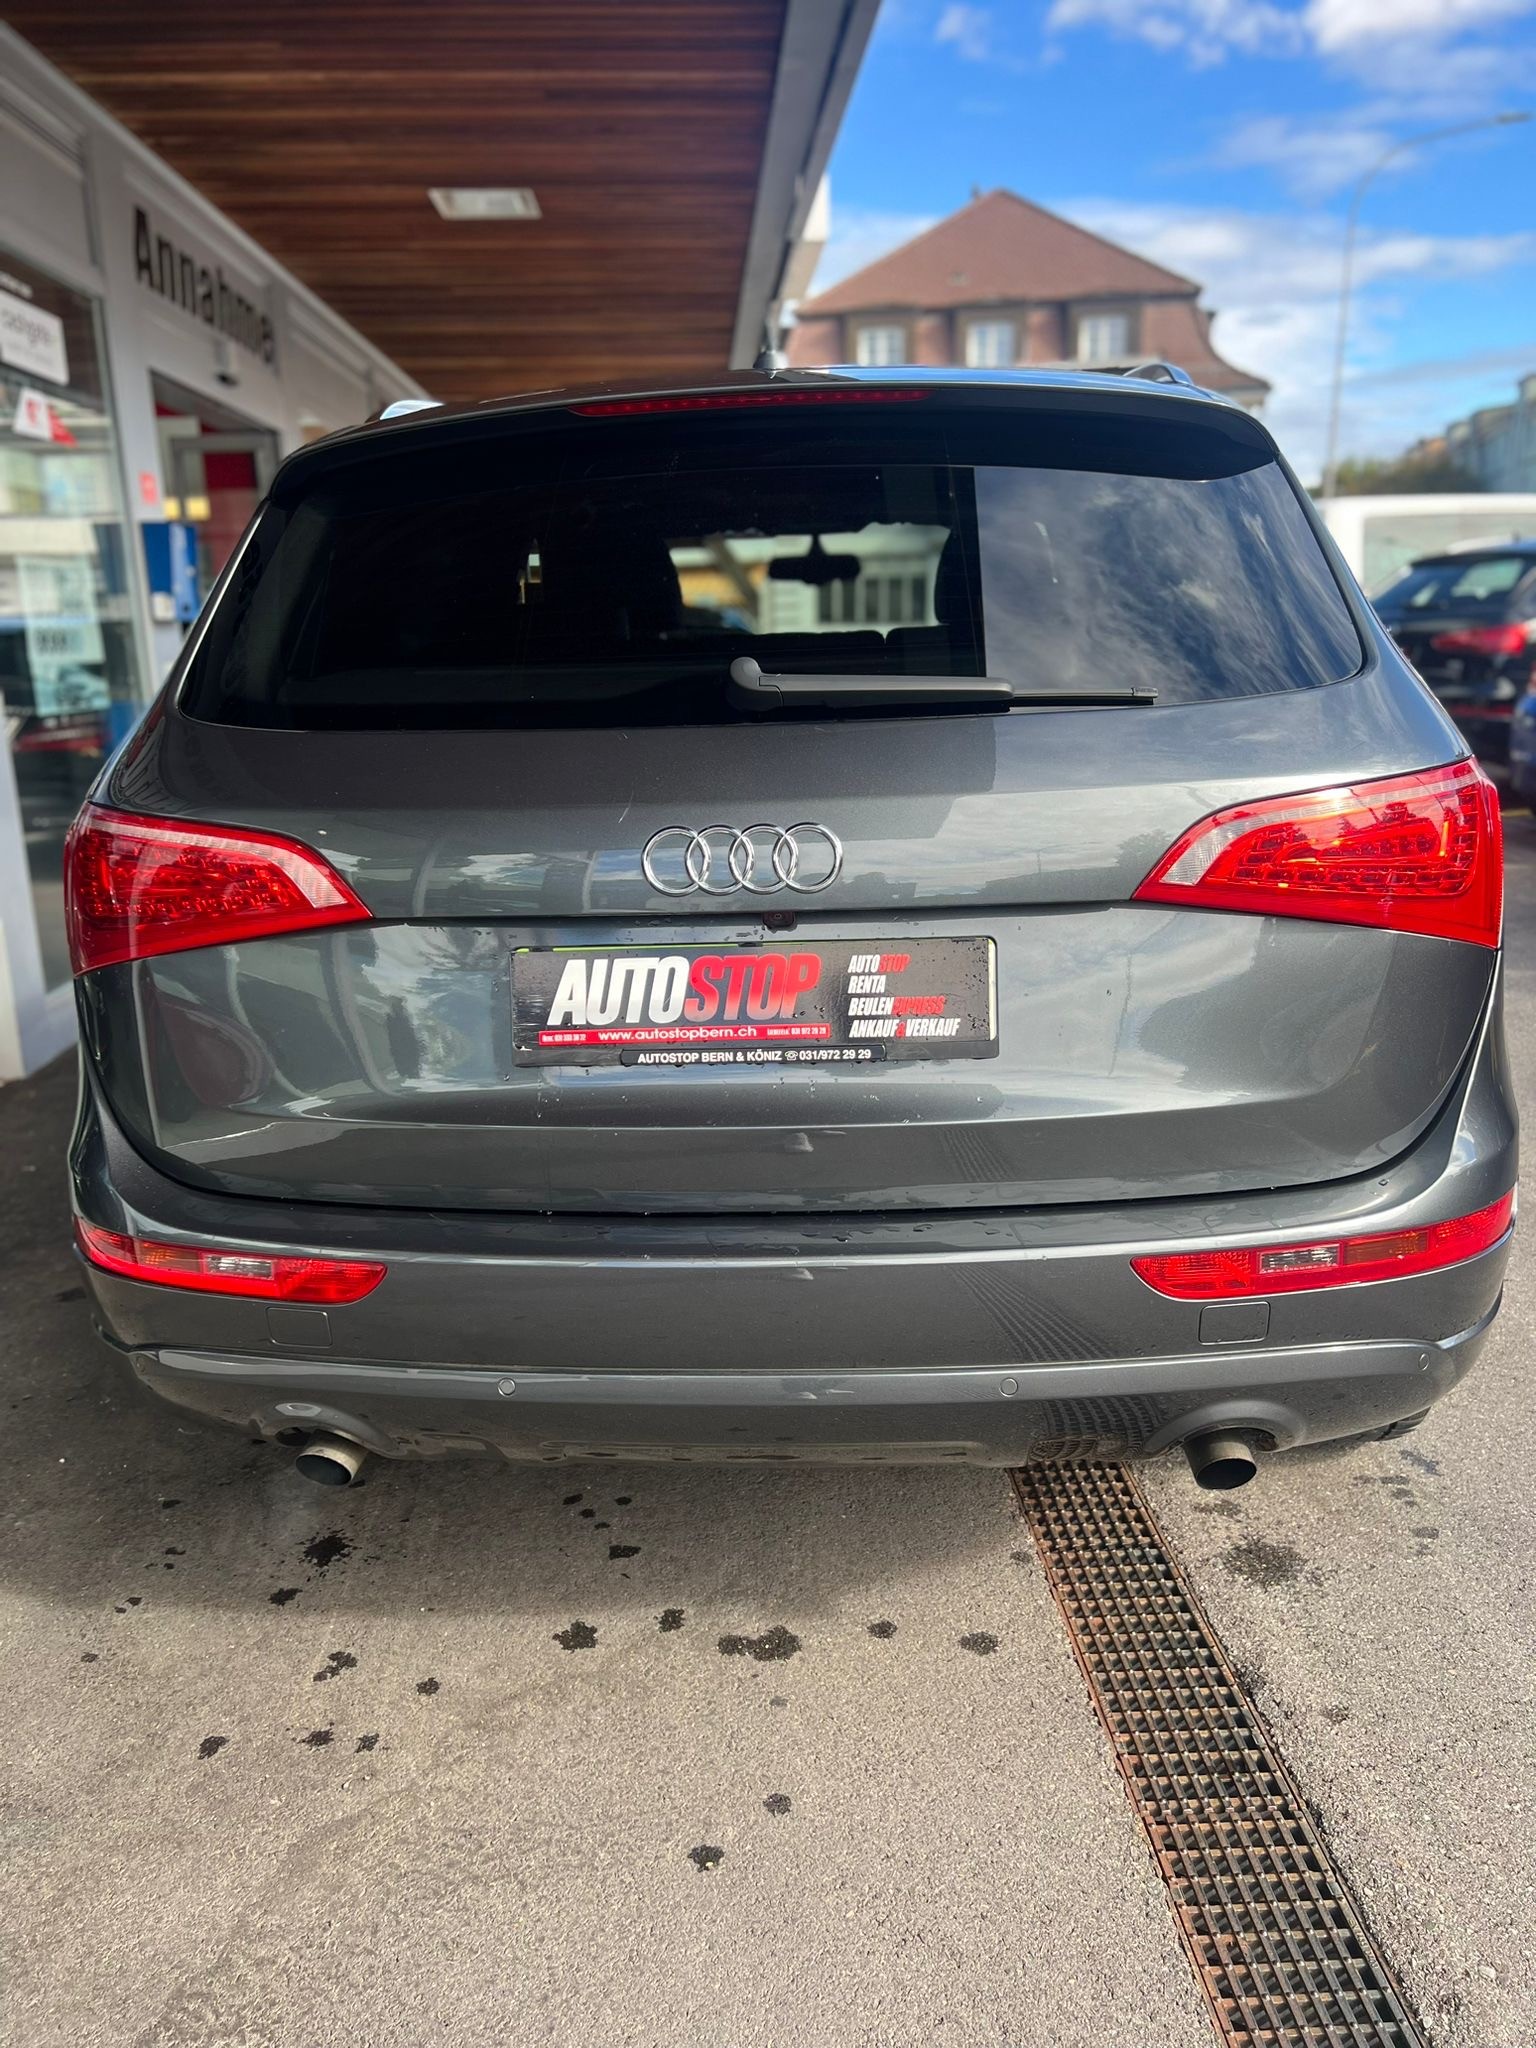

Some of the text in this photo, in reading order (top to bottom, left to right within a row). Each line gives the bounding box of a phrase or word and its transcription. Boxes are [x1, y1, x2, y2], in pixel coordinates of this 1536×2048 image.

[134, 206, 277, 366] Annahme
[847, 953, 911, 974] AUTOSTOP
[547, 954, 822, 1026] AUTOSTOP
[847, 974, 887, 994] RENTA
[598, 1026, 757, 1041] www.autostopbern.ch
[638, 1049, 871, 1064] AUTOSTOP BERN & KÖNIZ 031/972 29 29
